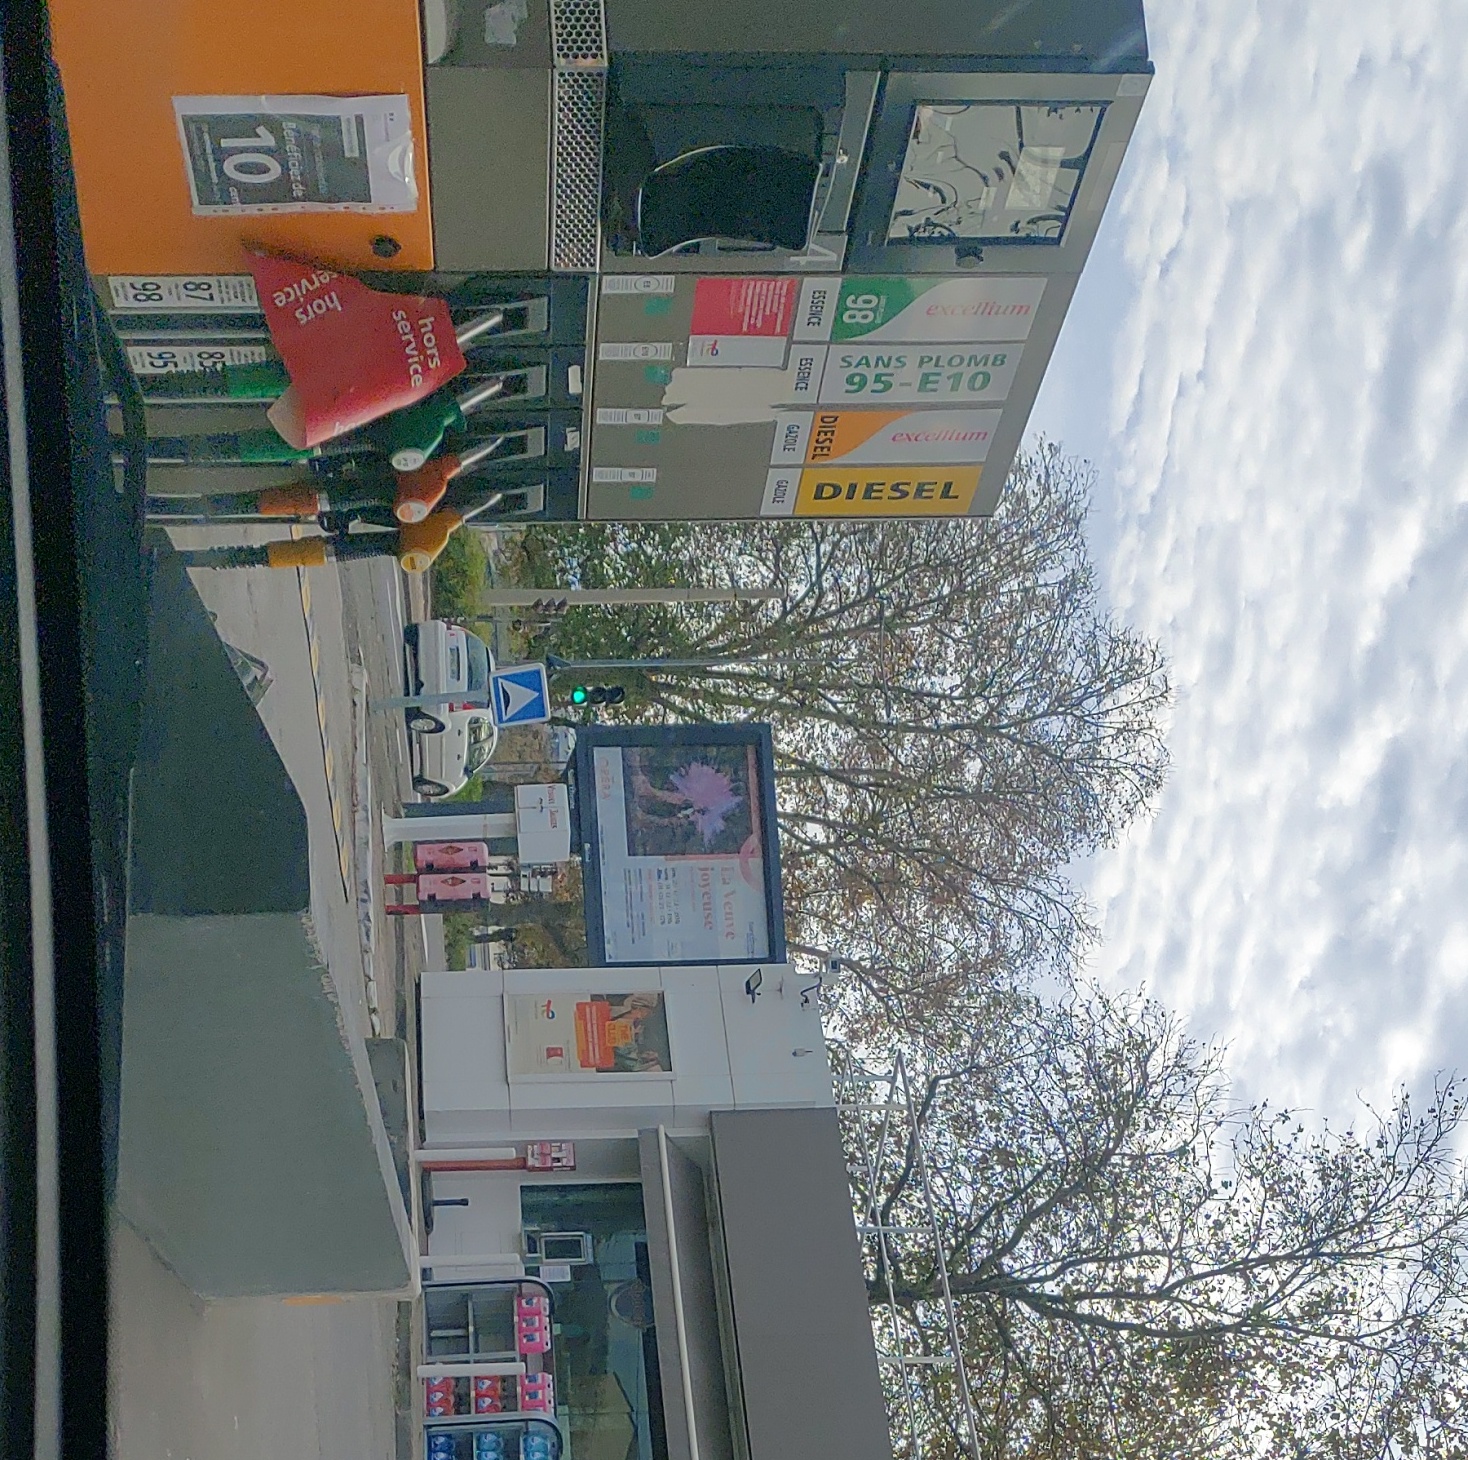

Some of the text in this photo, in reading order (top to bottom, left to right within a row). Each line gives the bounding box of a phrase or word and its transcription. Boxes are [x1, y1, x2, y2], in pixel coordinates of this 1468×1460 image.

[220, 125, 282, 184] 10
[292, 183, 306, 198] de
[790, 243, 837, 265] 4
[129, 282, 164, 302] 98
[182, 281, 214, 302] 87
[294, 292, 342, 324] hors
[807, 290, 827, 327] ESSENCE
[843, 294, 879, 324] 98
[926, 302, 1030, 316] excellium
[391, 310, 424, 388] service
[418, 316, 442, 369] hors
[146, 352, 178, 368] 95
[839, 354, 1007, 370] SANS PLOMB
[794, 357, 814, 392] ESSENCE
[844, 370, 991, 394] 95-E10
[782, 424, 800, 452] GAZOLE
[811, 415, 840, 460] DIESEL
[891, 430, 988, 442] excellium
[772, 479, 789, 504] GAZOLE
[813, 481, 960, 500] DIESEL
[698, 867, 714, 930] joyeuse
